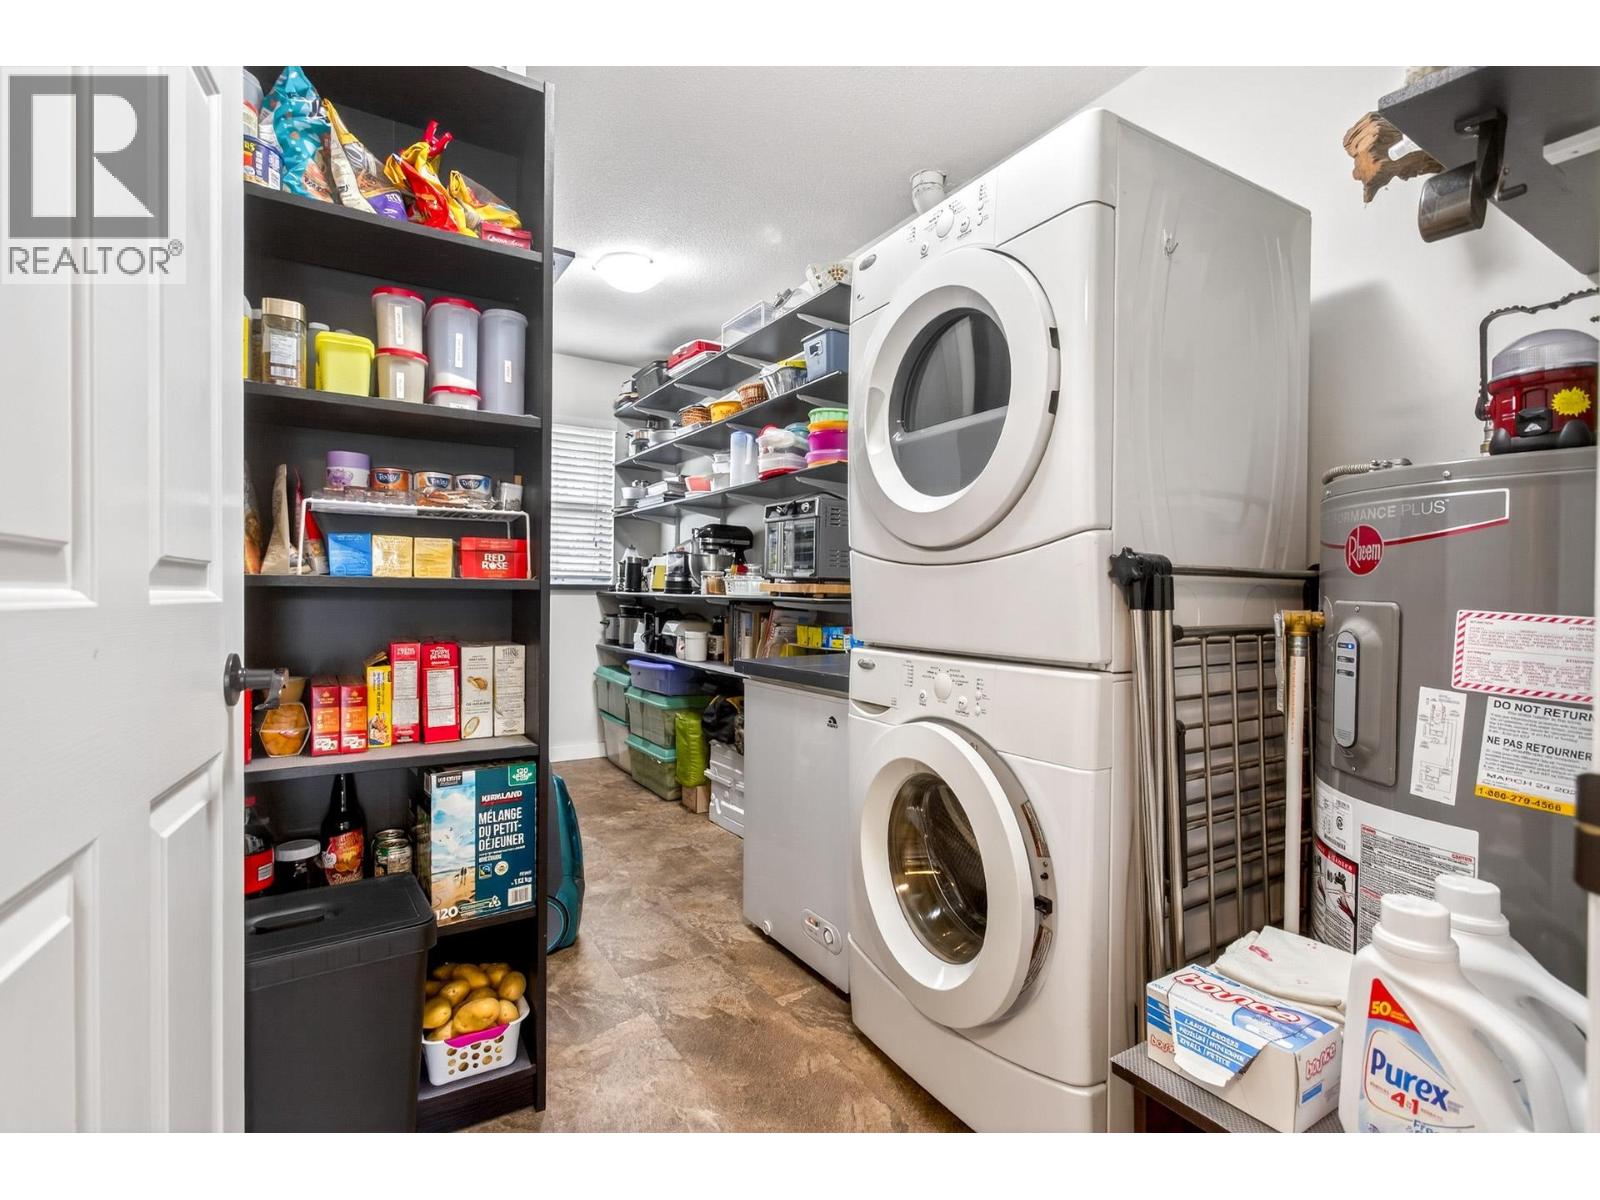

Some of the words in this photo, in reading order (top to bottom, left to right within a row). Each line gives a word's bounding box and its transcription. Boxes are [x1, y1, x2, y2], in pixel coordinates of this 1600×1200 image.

[1347, 526, 1381, 569] Rheem
[481, 561, 509, 570] ROSE
[484, 553, 506, 562] RED
[1493, 699, 1512, 710] DO
[1514, 703, 1542, 715] NOT
[1486, 735, 1501, 746] NE
[1503, 738, 1523, 750] PAS
[1526, 742, 1593, 762] RETOURNER
[481, 790, 523, 803] KIRKLAND
[479, 807, 523, 825] MÉLANGE
[479, 825, 491, 838] DU
[493, 821, 522, 836] PETIT-
[479, 833, 525, 852] DÉJEUNER
[434, 906, 458, 920] 120
[1371, 1000, 1392, 1016] 50
[1370, 1047, 1450, 1112] Purex
